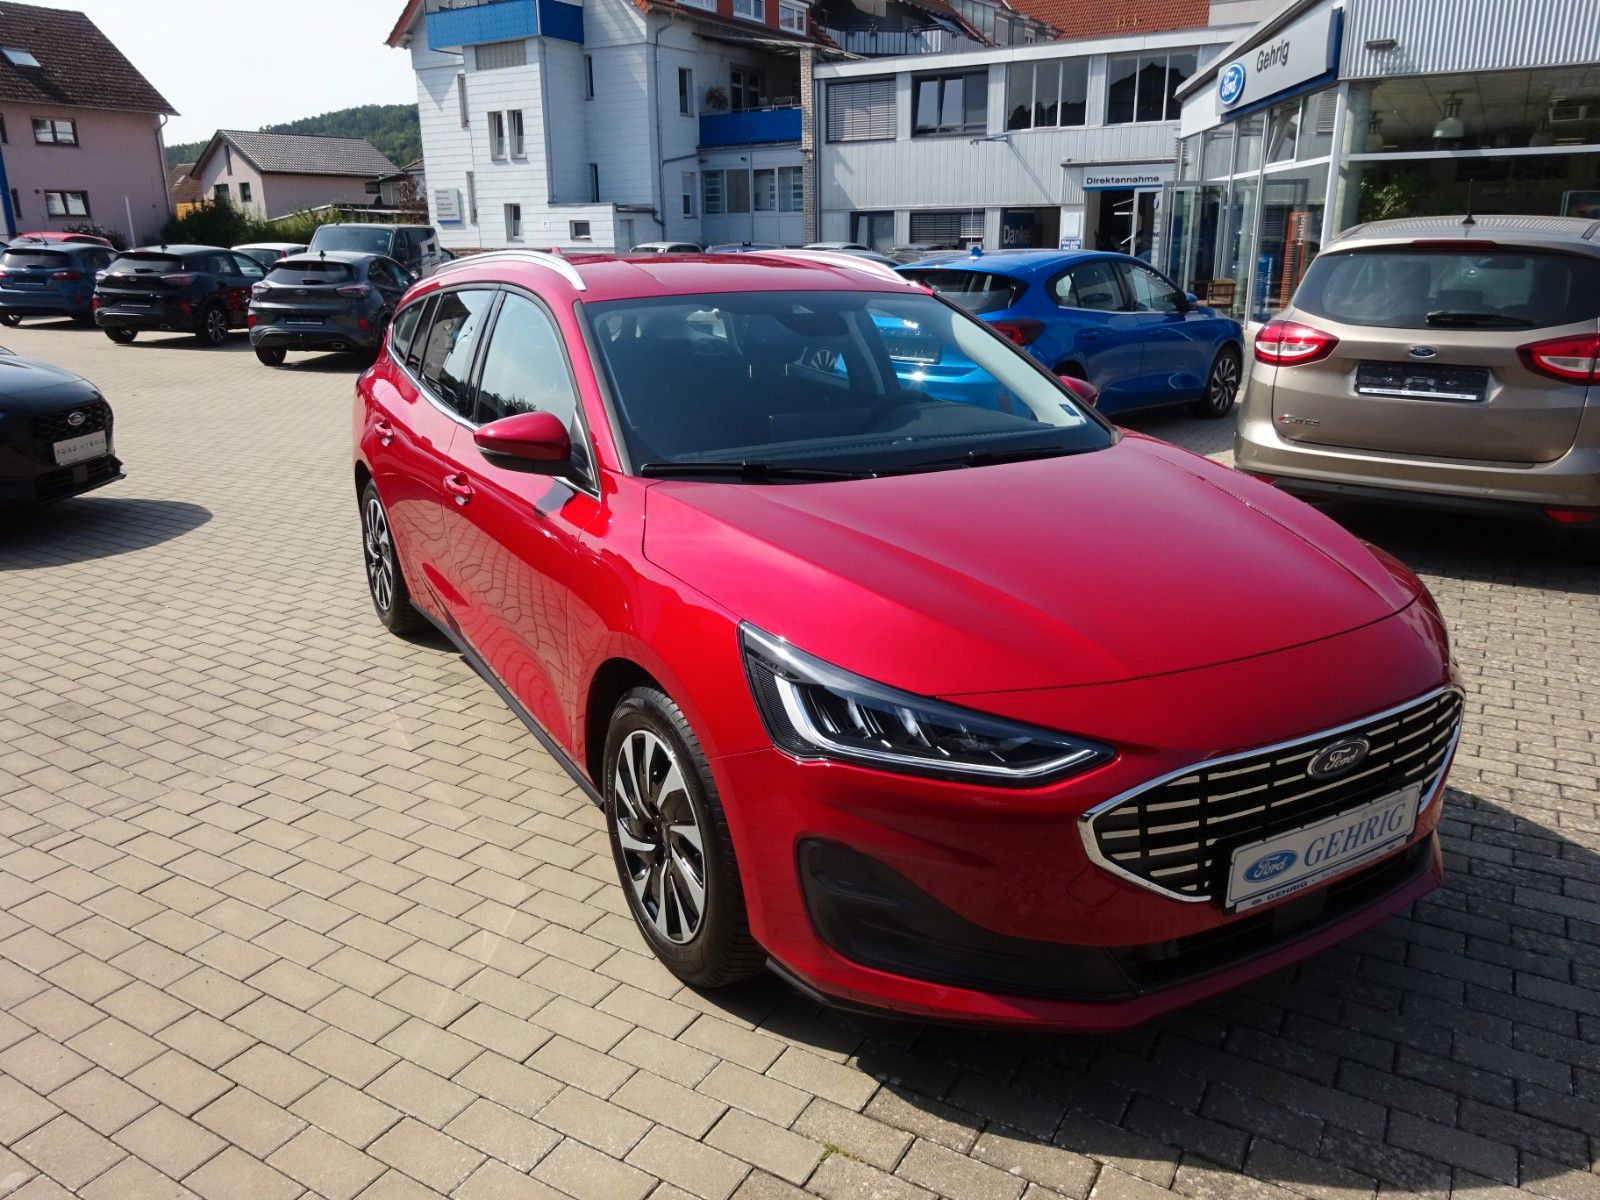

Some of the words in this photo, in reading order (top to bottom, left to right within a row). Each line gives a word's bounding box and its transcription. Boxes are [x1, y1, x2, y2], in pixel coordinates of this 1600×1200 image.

[1256, 39, 1290, 73] Gehrig
[1086, 174, 1160, 186] Direktannahme
[1324, 747, 1359, 771] Ford
[1303, 802, 1406, 867] GEHRIG
[1253, 855, 1289, 878] Ford
[1266, 880, 1308, 901] GEHRIG
